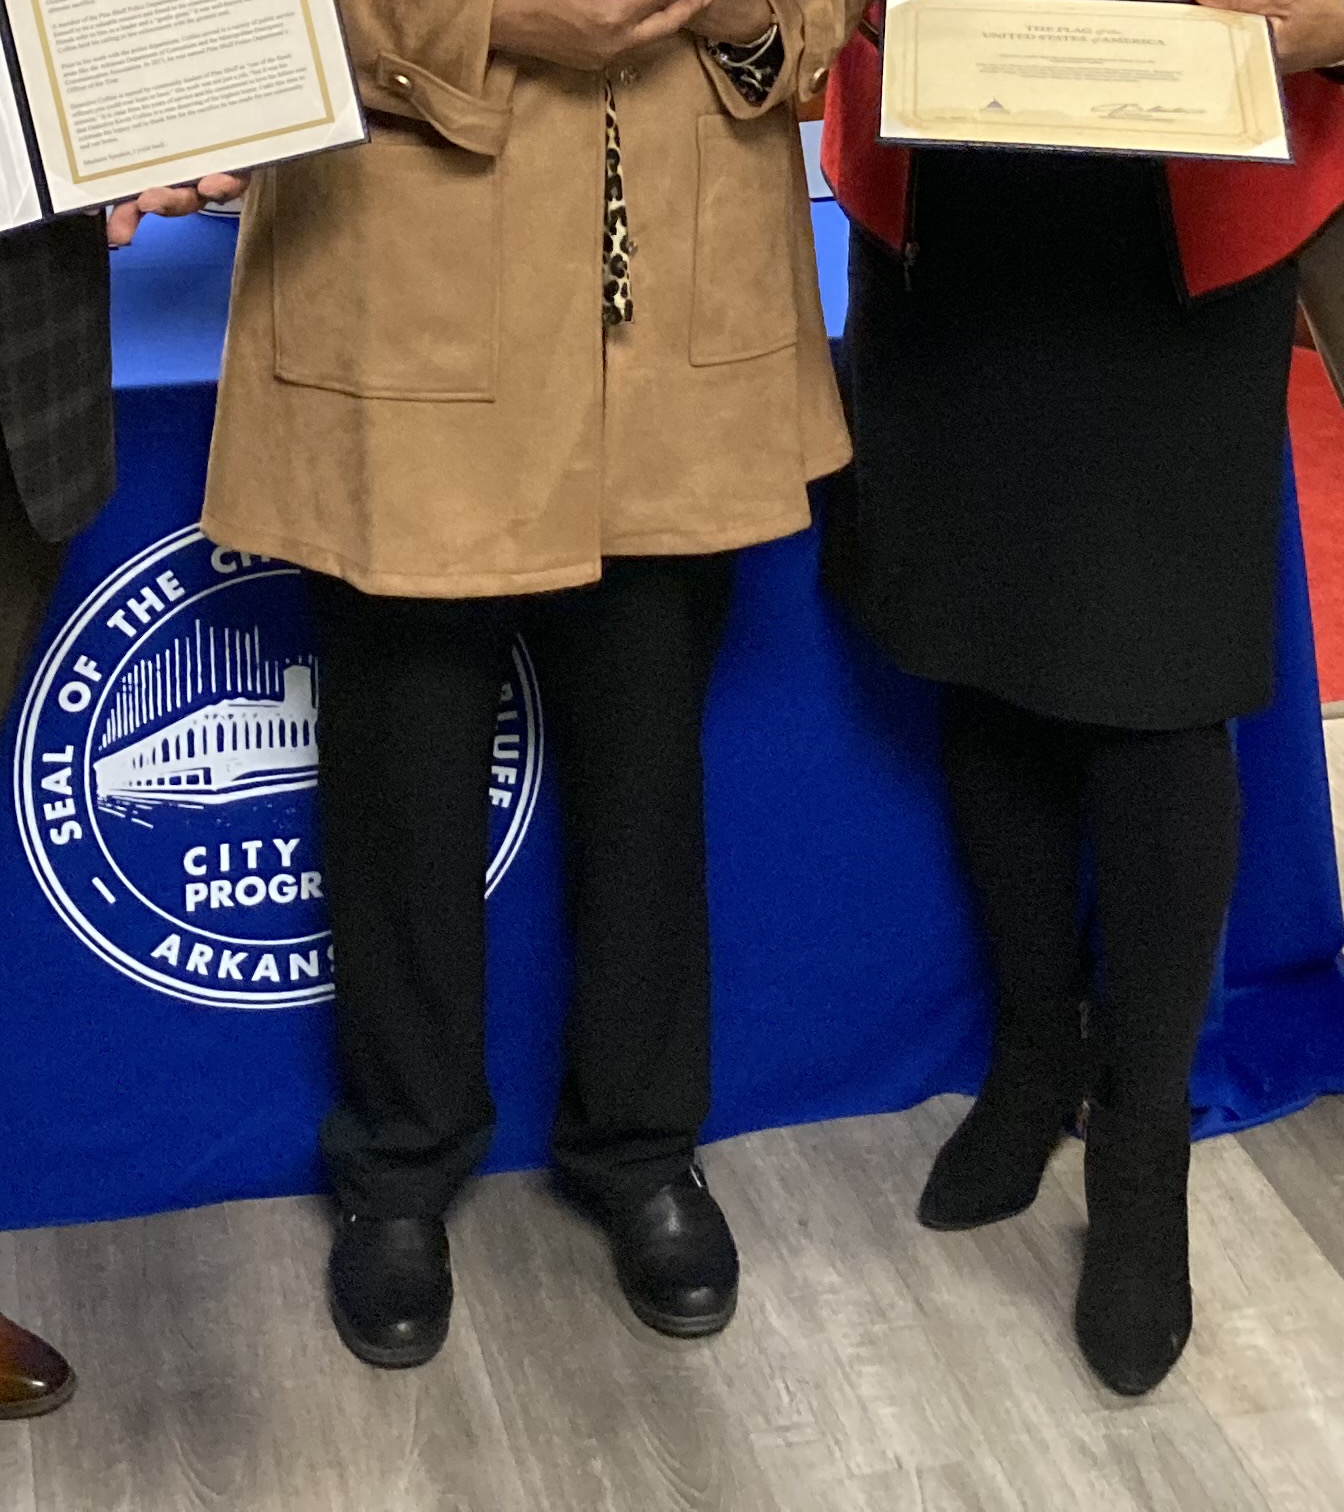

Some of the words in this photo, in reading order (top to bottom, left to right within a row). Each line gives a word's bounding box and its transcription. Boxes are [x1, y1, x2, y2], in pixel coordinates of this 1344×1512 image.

[107, 570, 185, 639] THE
[58, 655, 104, 713] OF
[41, 745, 83, 845] SEAL
[183, 838, 301, 876] CITY
[185, 871, 324, 912] PROGR
